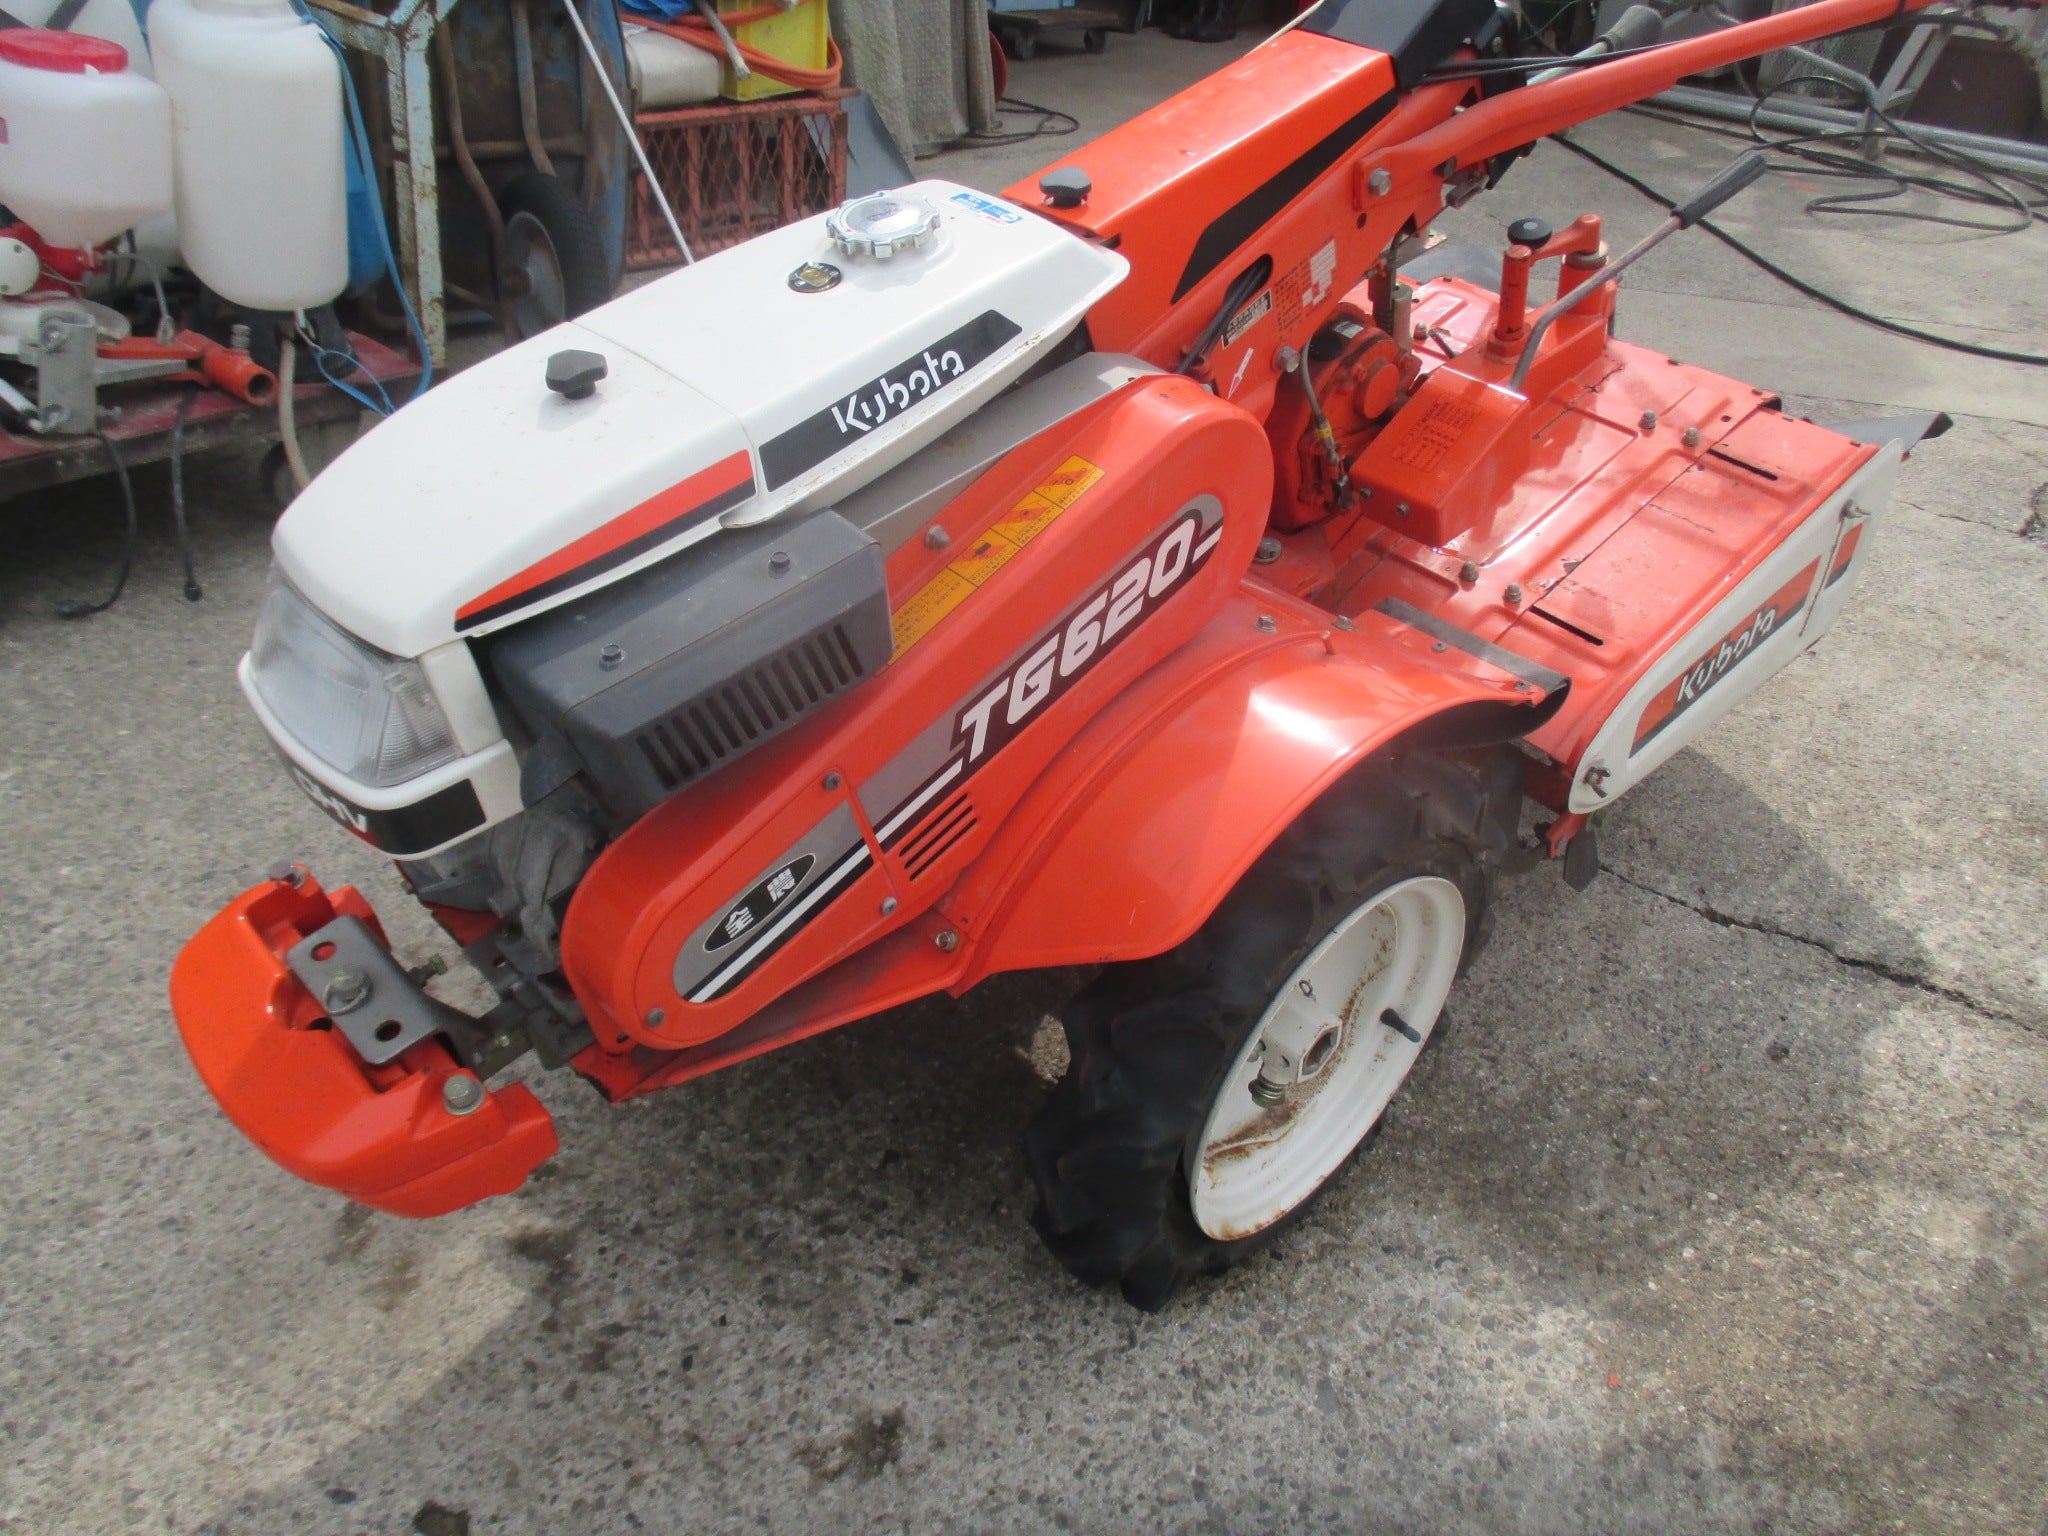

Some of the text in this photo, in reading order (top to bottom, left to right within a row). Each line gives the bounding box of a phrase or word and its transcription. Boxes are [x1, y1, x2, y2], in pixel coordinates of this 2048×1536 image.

[831, 350, 965, 433] Kubota
[961, 518, 1196, 762] TG620
[1676, 607, 1776, 702] Kubota
